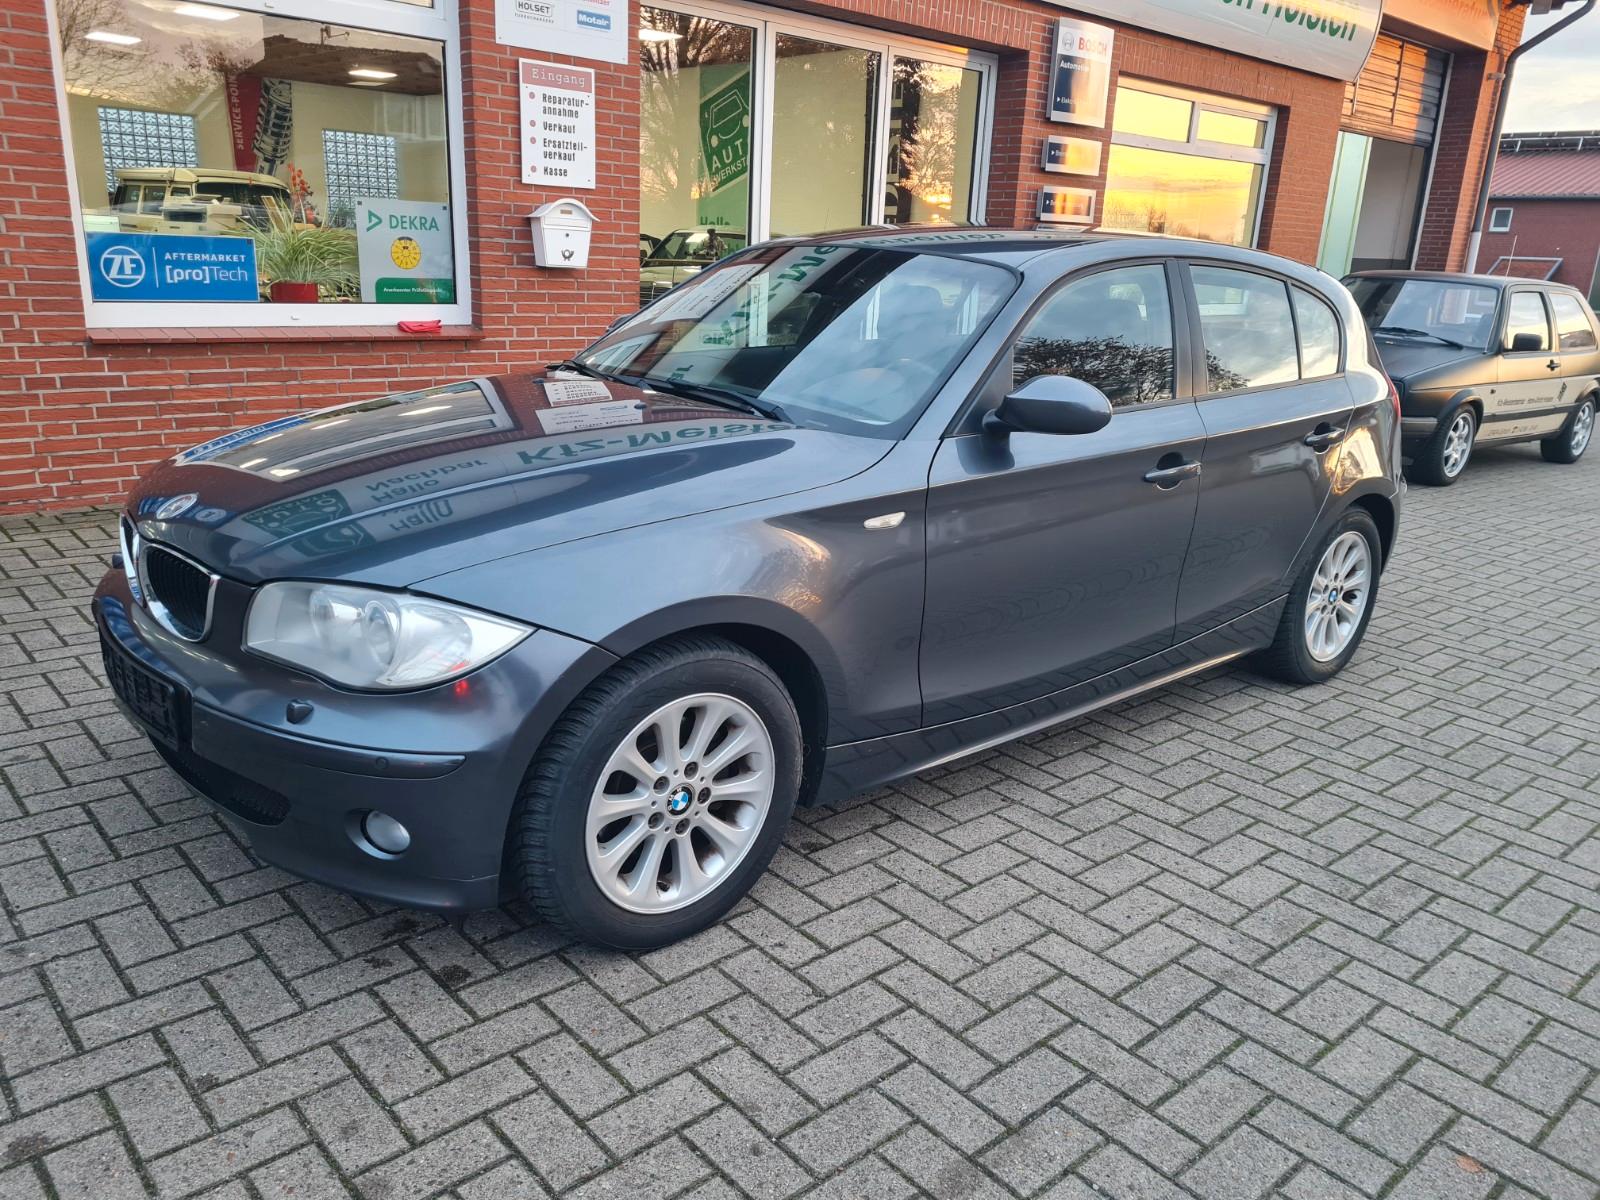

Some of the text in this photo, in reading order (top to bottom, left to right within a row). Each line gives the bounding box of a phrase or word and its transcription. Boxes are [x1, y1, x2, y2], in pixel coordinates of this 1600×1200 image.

[518, 1, 551, 14] HOLSET
[578, 13, 610, 26] Motair
[1078, 37, 1108, 57] BOSCH
[531, 68, 586, 87] Eingang
[542, 93, 590, 107] Reparatur-
[542, 105, 579, 119] annahme
[543, 121, 576, 134] Verkauf
[543, 137, 588, 152] Ersatzteil-
[543, 151, 576, 162] verkauf
[543, 165, 568, 177] Kasse
[389, 214, 440, 232] DEKRA
[164, 252, 246, 263] AFTERMARKET
[102, 249, 143, 282] ZF
[166, 265, 248, 284] [pro]Tech
